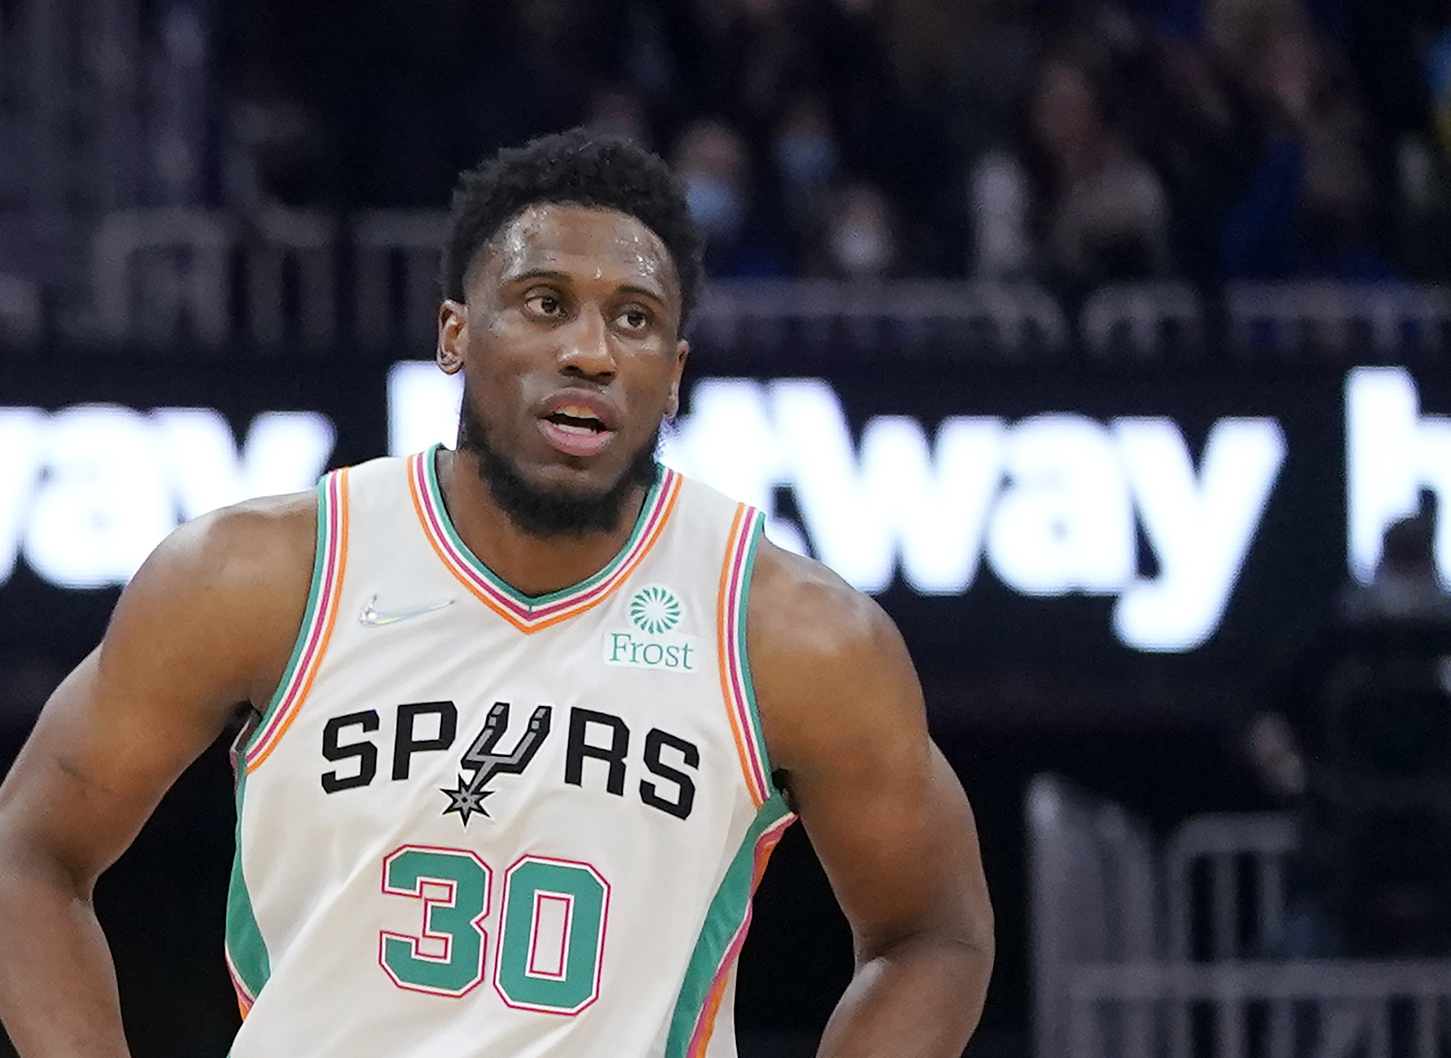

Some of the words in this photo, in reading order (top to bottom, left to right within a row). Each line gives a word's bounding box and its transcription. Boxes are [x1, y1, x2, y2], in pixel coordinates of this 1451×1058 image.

[387, 358, 1285, 653] tway
[609, 632, 694, 670] Frost
[321, 699, 700, 828] SPURS
[378, 844, 611, 1016] 30
